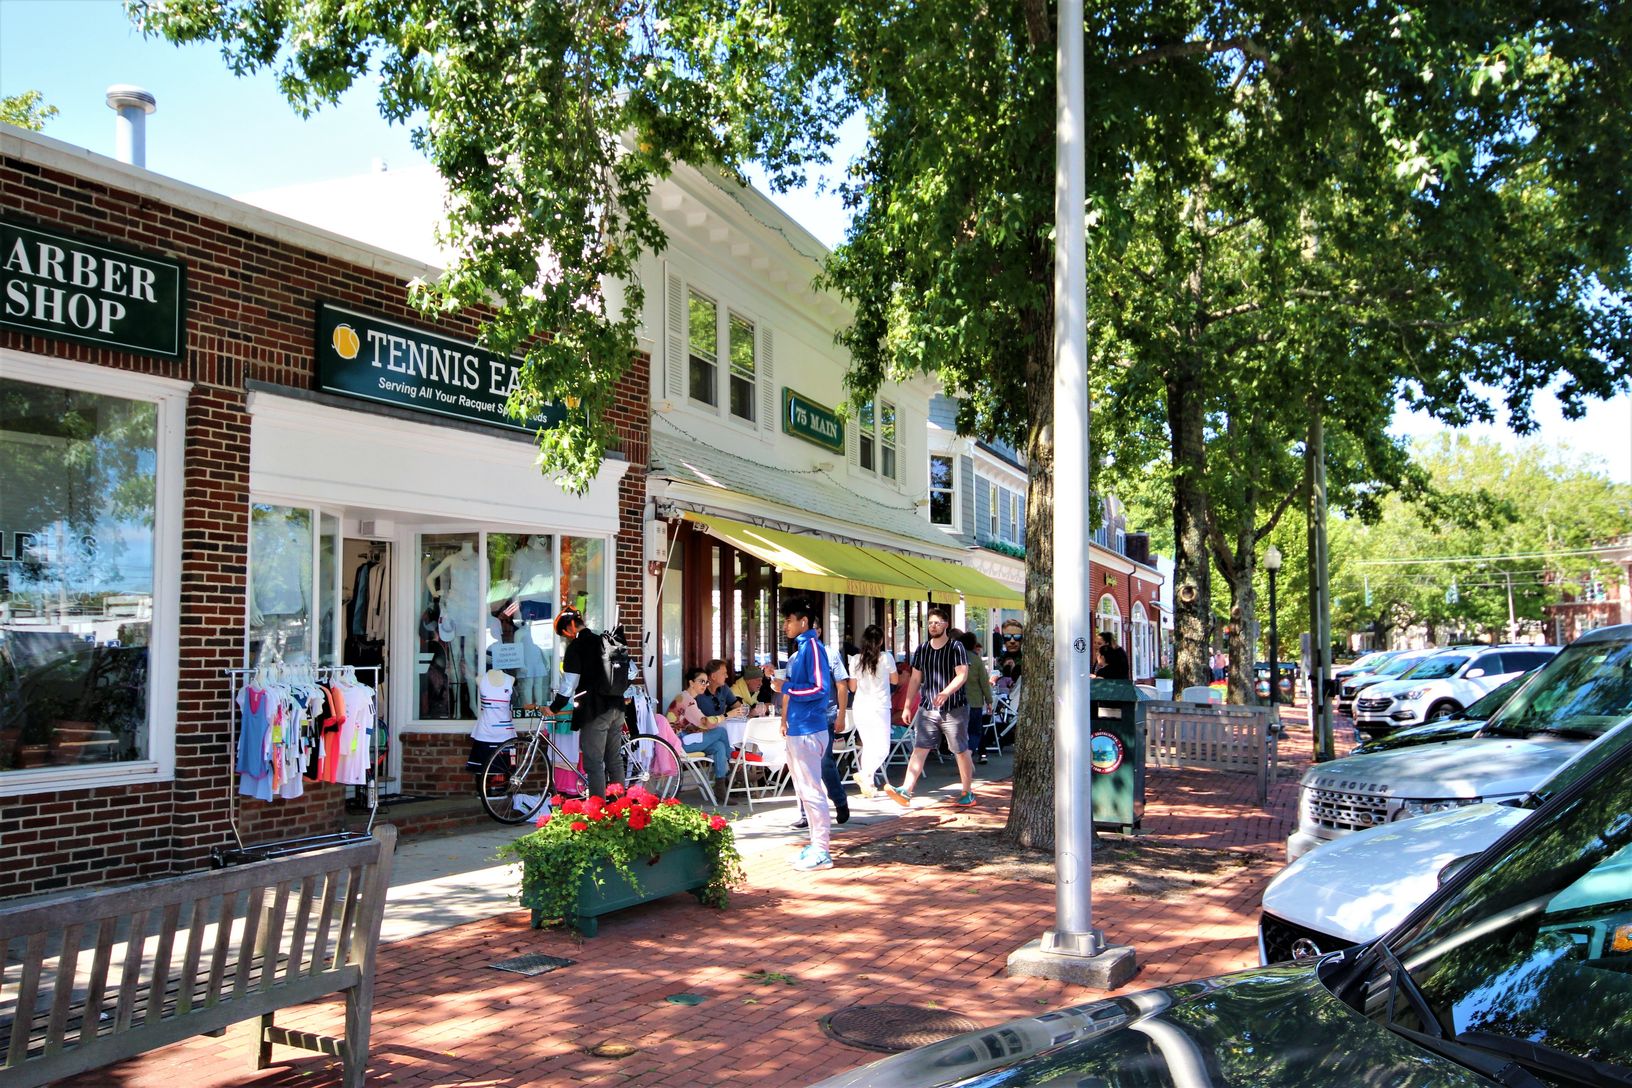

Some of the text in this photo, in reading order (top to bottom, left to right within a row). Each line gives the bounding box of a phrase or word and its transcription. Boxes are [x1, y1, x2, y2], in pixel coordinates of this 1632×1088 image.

[3, 236, 158, 303] ARBER
[5, 279, 127, 335] SHOP
[367, 329, 480, 390] TENNIS
[378, 376, 417, 398] Serving
[418, 386, 433, 399] All
[435, 389, 457, 405] Your
[459, 395, 495, 413] Racquet
[796, 405, 838, 439] 75 MAIN
[1340, 780, 1389, 793] ROVER
